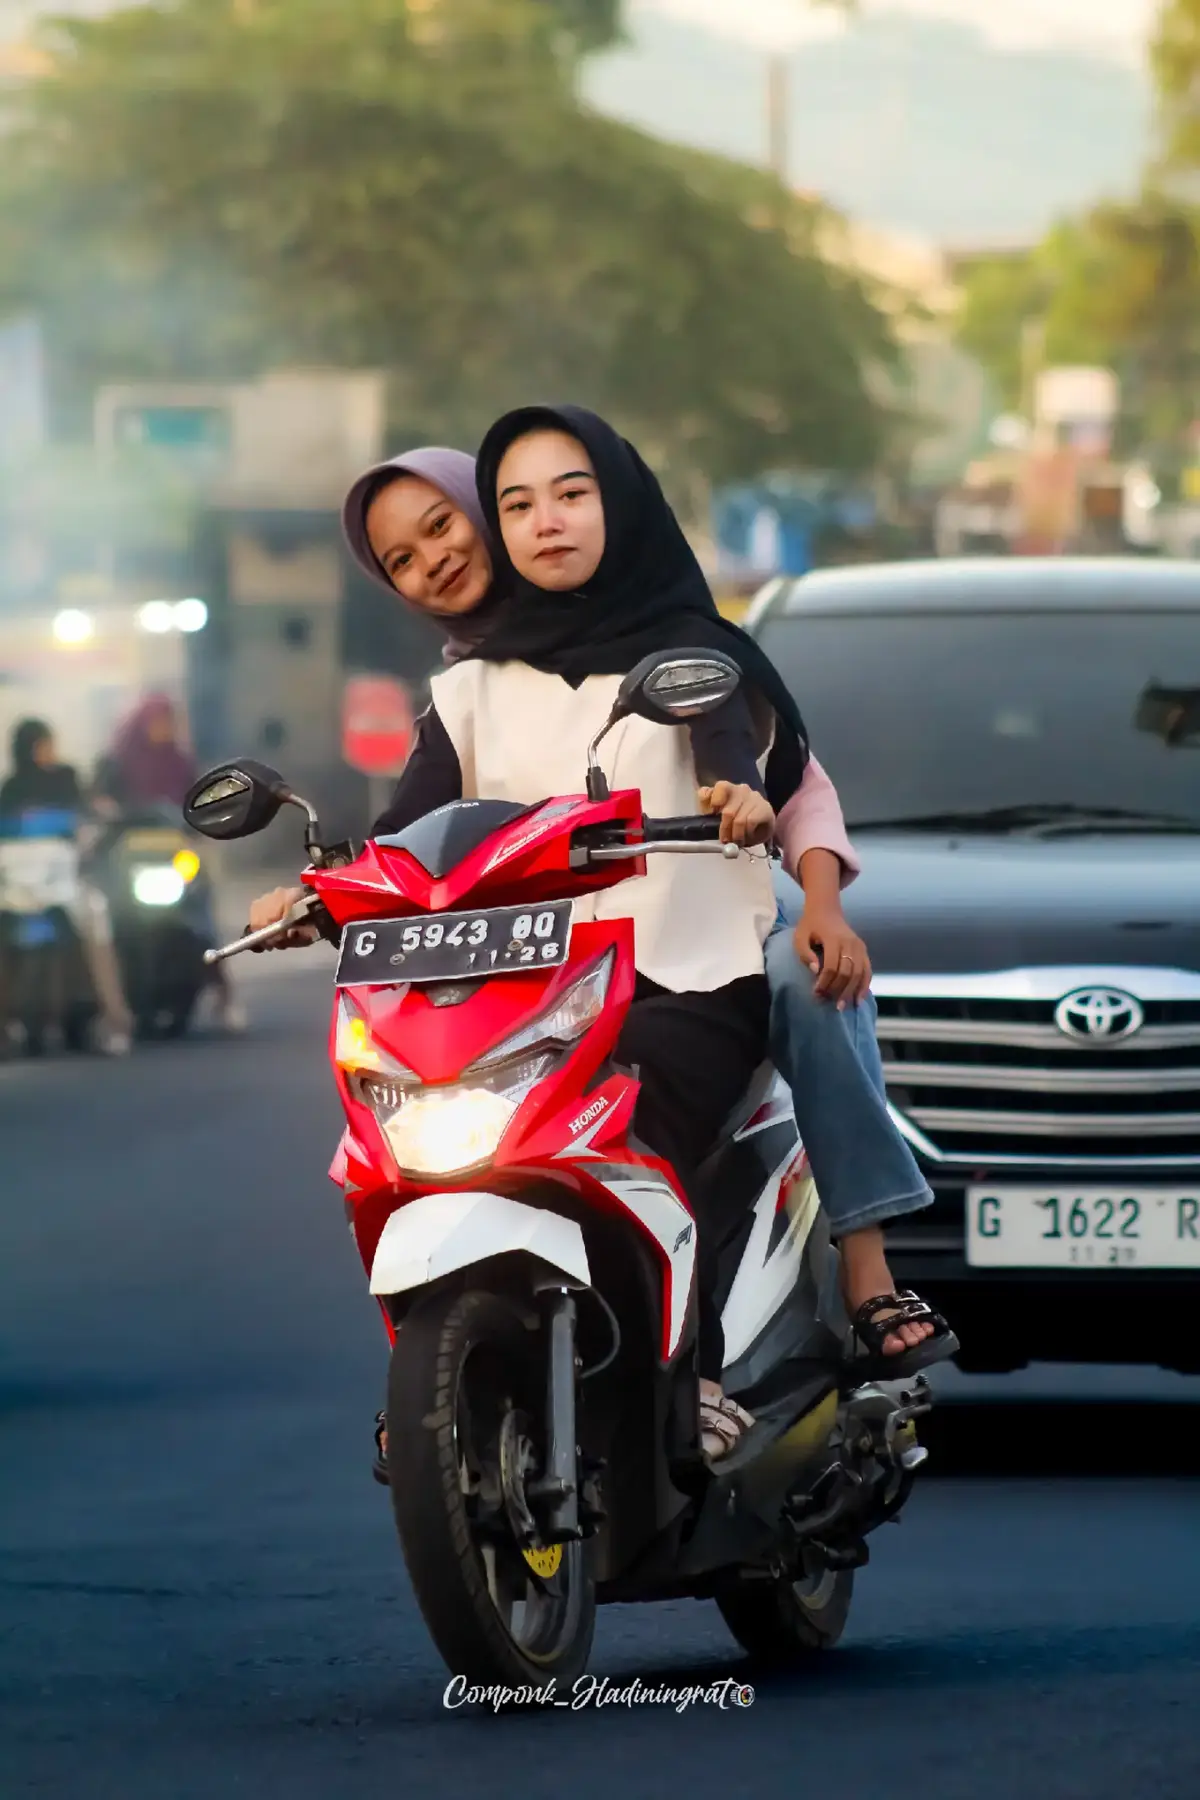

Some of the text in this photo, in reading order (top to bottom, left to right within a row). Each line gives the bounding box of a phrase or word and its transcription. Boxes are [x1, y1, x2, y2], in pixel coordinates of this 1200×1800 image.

[355, 931, 377, 956] G
[401, 919, 488, 951] 5943
[568, 1096, 609, 1135] HONDA
[977, 1196, 1200, 1239] G 1622 R
